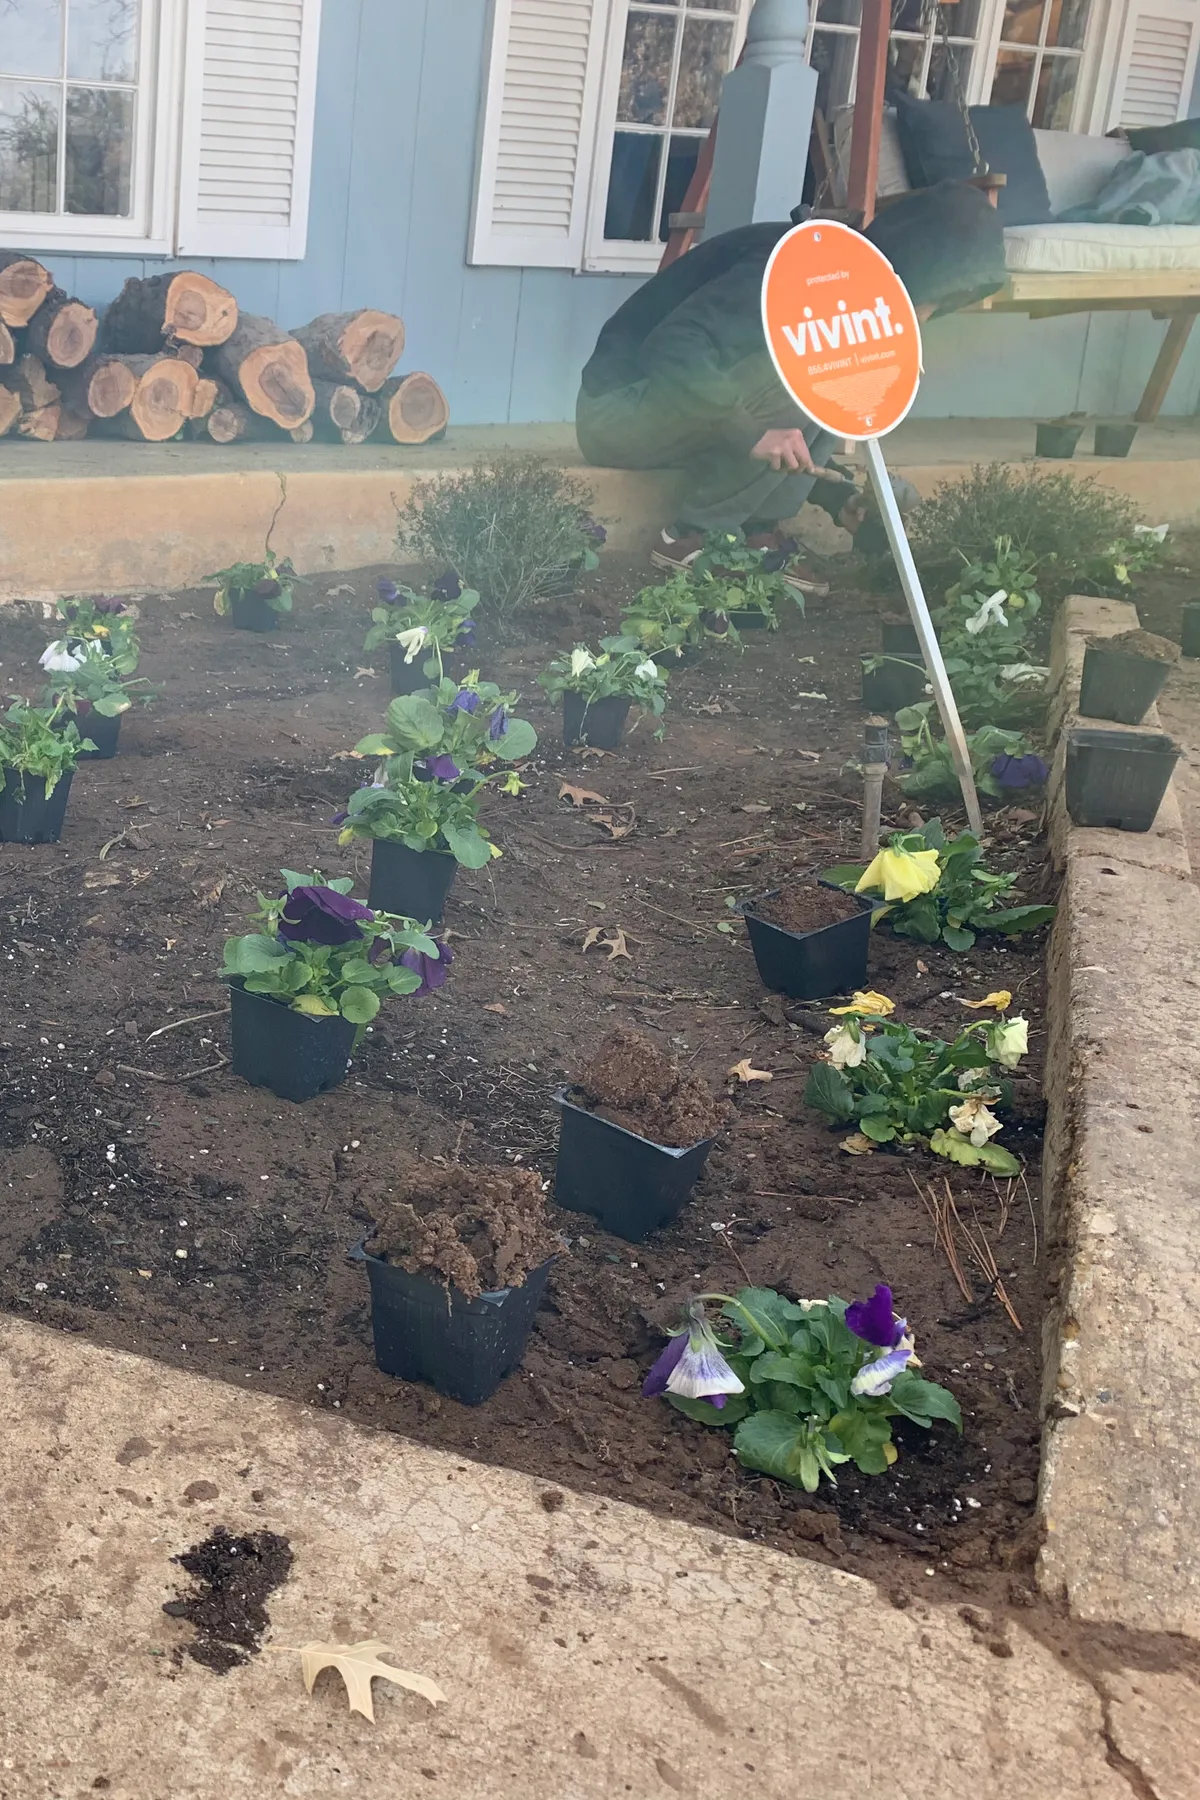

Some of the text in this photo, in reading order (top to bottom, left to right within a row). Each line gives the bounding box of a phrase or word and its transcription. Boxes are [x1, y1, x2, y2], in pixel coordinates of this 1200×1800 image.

[806, 270, 850, 286] protected by
[782, 296, 903, 356] vivint.
[860, 350, 896, 363] vivint.com
